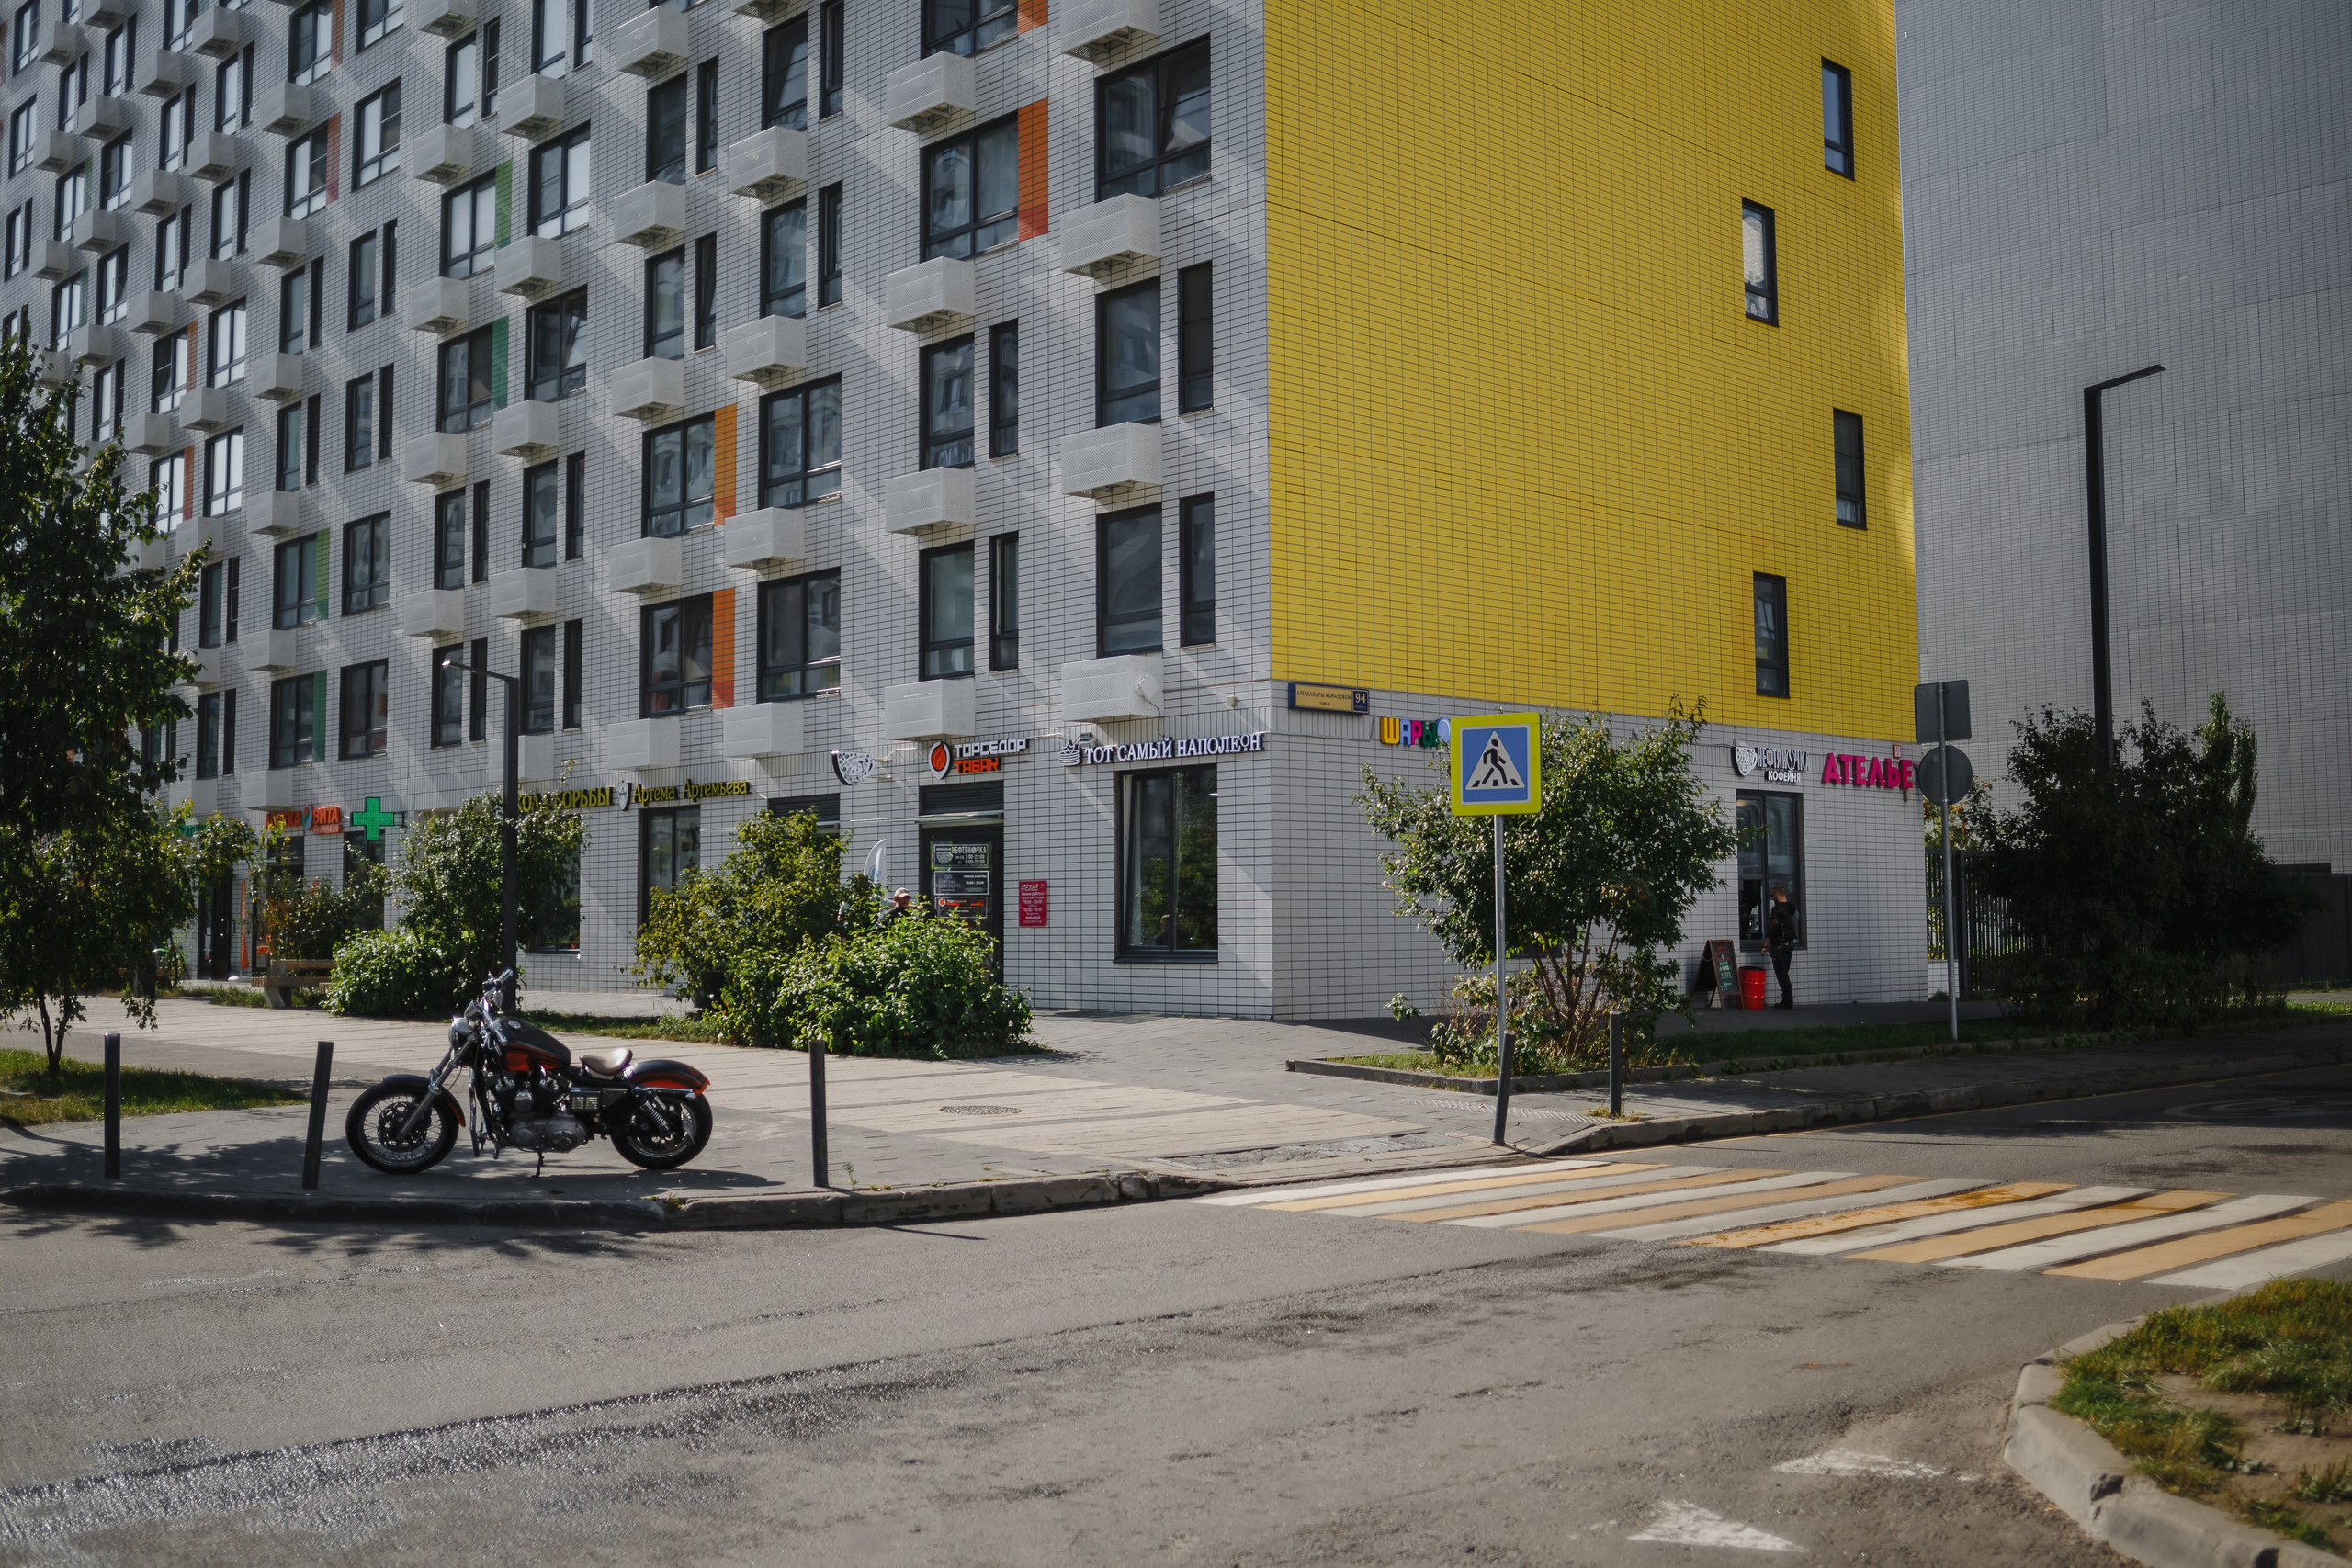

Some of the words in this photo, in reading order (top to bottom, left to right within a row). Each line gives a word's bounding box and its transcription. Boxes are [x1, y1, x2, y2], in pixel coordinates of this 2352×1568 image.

[1355, 693, 1366, 704] 94
[1380, 716, 1437, 747] ШАРЫ
[954, 738, 1026, 758] ТОРСЕДОР
[1085, 746, 1114, 764] ТОТ
[1117, 738, 1172, 761] САМЫЙ
[1177, 733, 1261, 757] НАПОЛЕОН
[1757, 747, 1810, 771] НЕФТЯНОЧКА
[954, 758, 999, 773] ТАБАК
[1822, 752, 1913, 789] АТЕЛЬЕ
[1768, 771, 1801, 783] КОФЕЙНЯ
[554, 787, 610, 810] БОРЬБЫ
[633, 784, 675, 806] Артема
[683, 780, 747, 802] Артемьева
[313, 807, 339, 825] ВИТА
